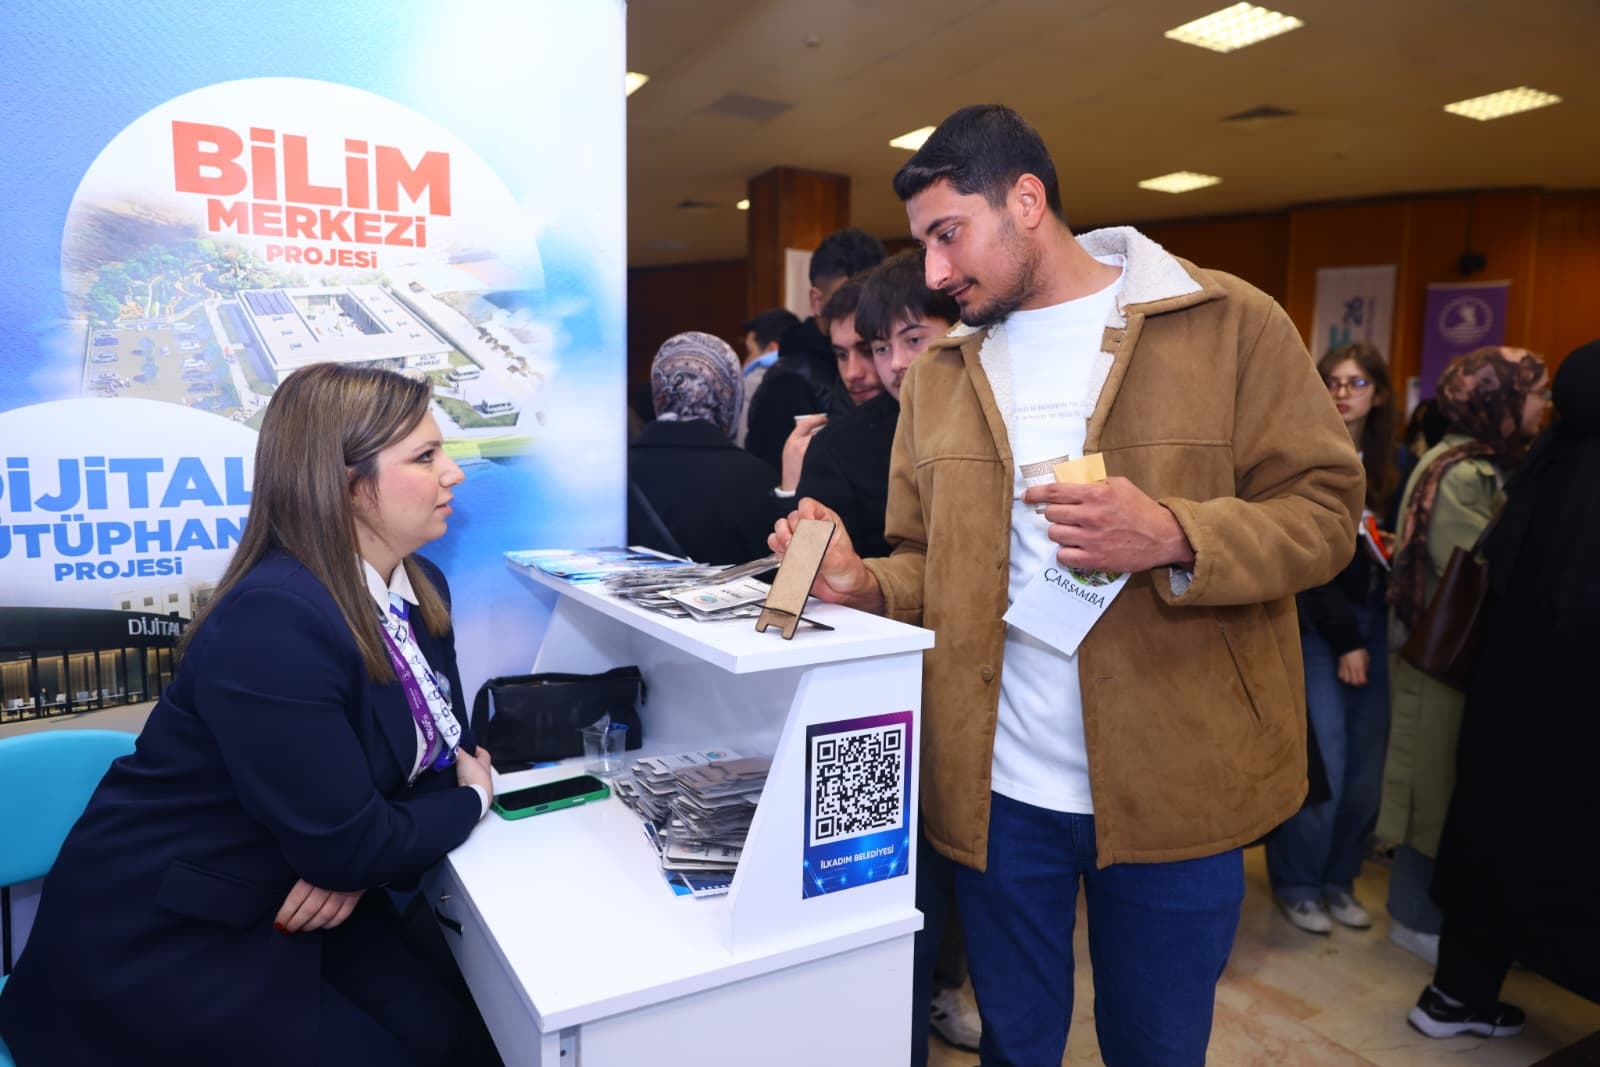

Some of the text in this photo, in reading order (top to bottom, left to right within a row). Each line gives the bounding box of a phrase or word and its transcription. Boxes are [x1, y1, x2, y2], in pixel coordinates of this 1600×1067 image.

[207, 198, 426, 248] MERKEZİ
[266, 243, 378, 269] PROJESİ
[0, 456, 252, 513] İJİTAL
[54, 556, 182, 581] PROJESİ
[820, 844, 894, 870] İLKADIM BELEDİYESİ
